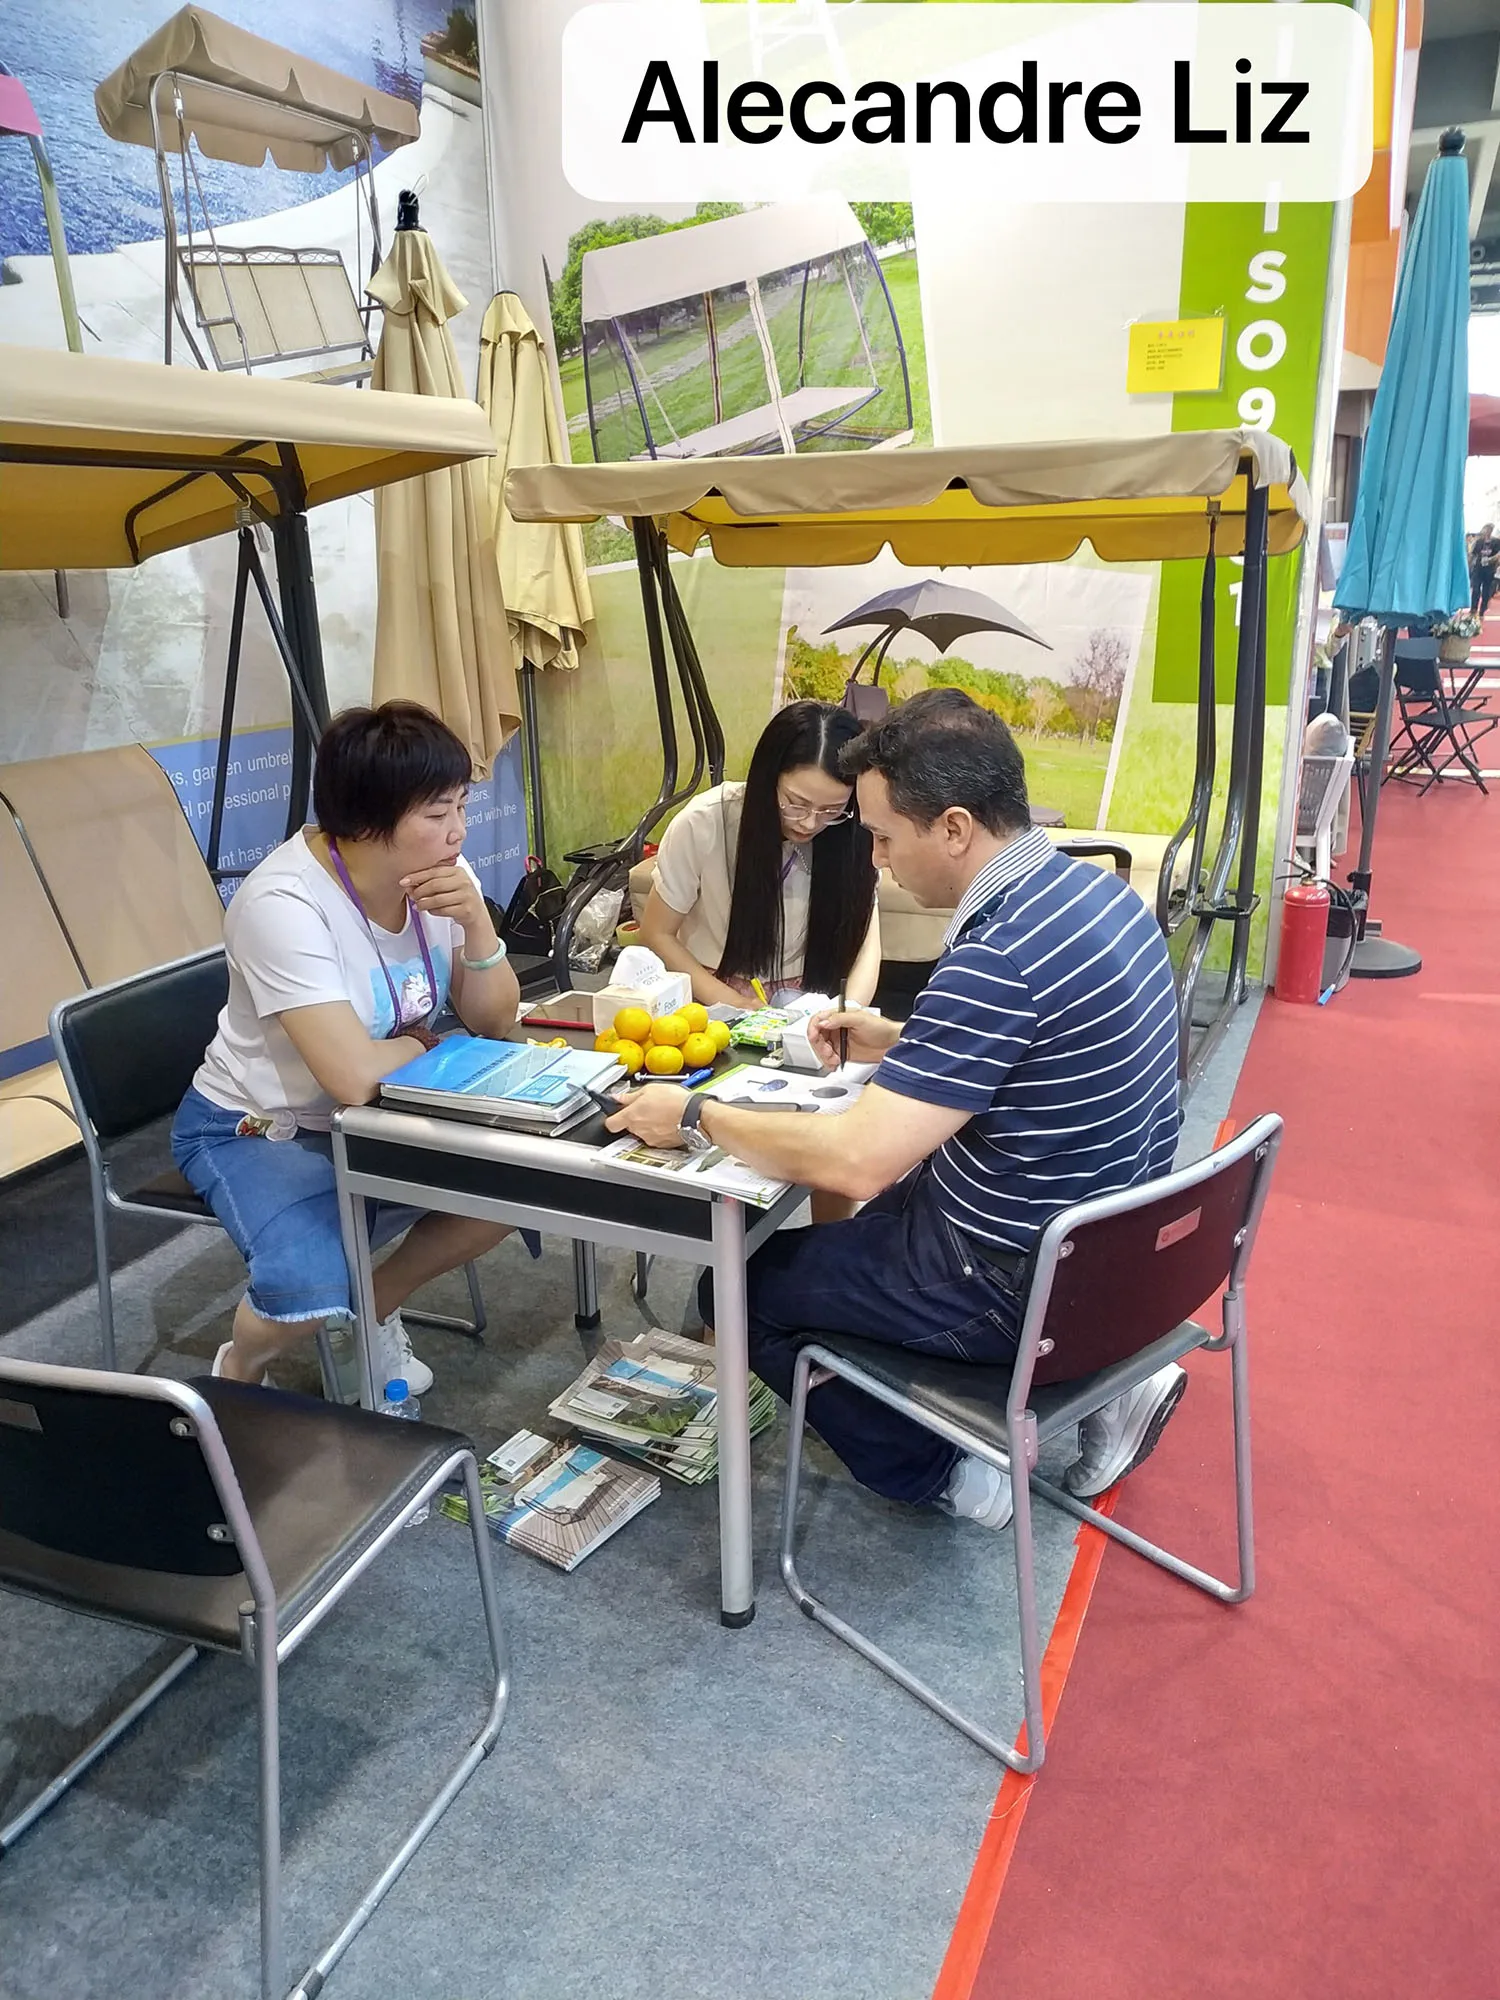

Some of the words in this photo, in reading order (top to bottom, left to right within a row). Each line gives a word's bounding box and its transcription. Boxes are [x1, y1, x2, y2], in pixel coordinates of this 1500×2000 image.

[192, 759, 242, 787] garen
[247, 748, 293, 772] umbrel
[503, 802, 517, 817] the
[237, 847, 263, 864] has
[504, 843, 521, 860] and
